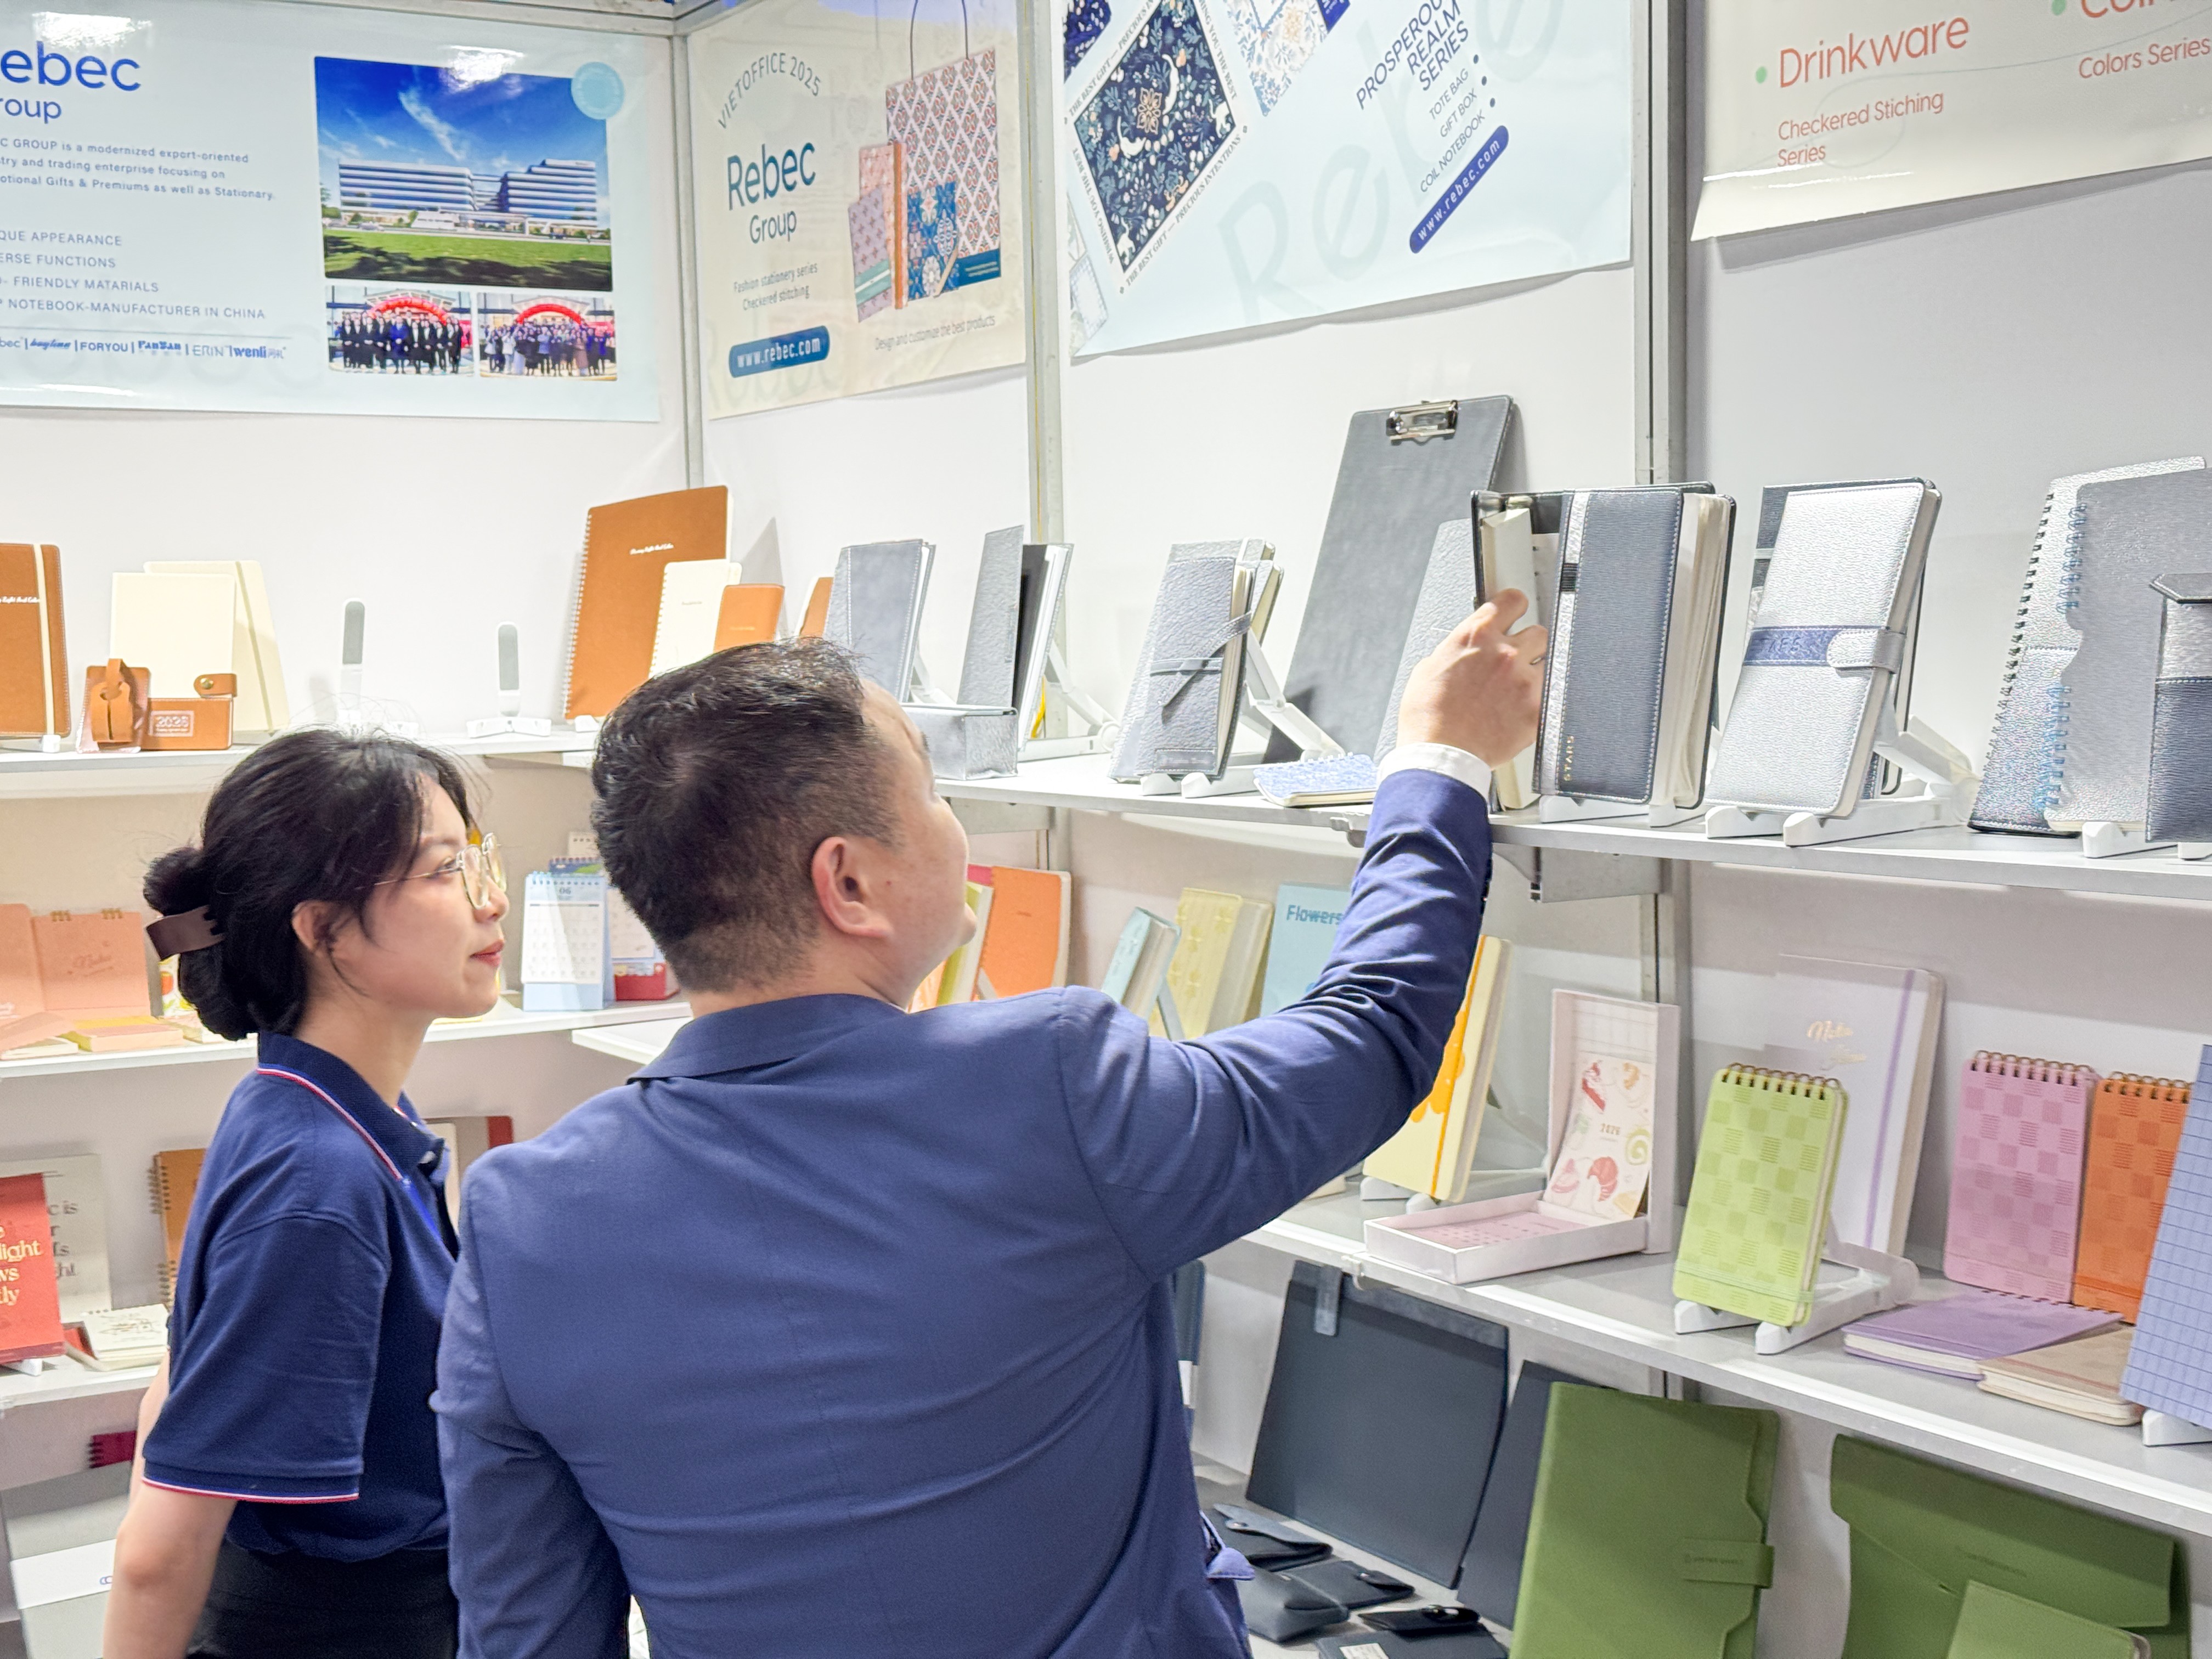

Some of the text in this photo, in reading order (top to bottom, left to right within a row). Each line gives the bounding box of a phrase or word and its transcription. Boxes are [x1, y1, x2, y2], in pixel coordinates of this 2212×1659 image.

[1407, 0, 1461, 75] REALM
[1419, 20, 1469, 91] SERIES
[1779, 15, 1970, 88] Drinkware
[2079, 37, 2211, 78] Colors Series
[0, 41, 142, 92] ebec
[789, 56, 821, 97] 2025
[1069, 6, 1147, 116] THE BEST GIFT PRECIOUS
[1209, 24, 1220, 49] YOU
[1216, 48, 1228, 74] THE
[1224, 72, 1238, 100] BEST
[0, 98, 62, 124] oup
[1429, 68, 1469, 120] TOTE BAG
[1440, 88, 1477, 138] GIFT BOX
[1778, 92, 1944, 140] Checkered Stiching
[0, 156, 225, 179] try and trading enterprise focusing on
[13, 139, 57, 150] GROUP
[87, 145, 155, 157] modernized
[159, 149, 249, 163] export-oriented
[1420, 109, 1486, 192] COIL NOTEBOOK
[1778, 144, 1826, 167] Series
[46, 176, 74, 187] Gifts
[79, 178, 87, 188] &
[92, 179, 150, 191] Premiums
[154, 184, 167, 193] as
[171, 184, 194, 194] well
[198, 187, 211, 195] as
[727, 143, 816, 211] Rebec
[1418, 140, 1500, 241] www.rebec.com
[31, 232, 122, 246] APPEARANCE
[749, 210, 797, 244] Group
[1126, 267, 1139, 286] THE
[1137, 249, 1154, 272] BEST
[1152, 230, 1167, 252] GIFT
[1175, 182, 1206, 223] PRECIOUS
[37, 255, 116, 268] FUNCTIONS
[733, 279, 759, 293] Fashion
[797, 262, 817, 277] series
[14, 276, 79, 289] FRIENDLY
[84, 279, 159, 292] MATARIALS
[8, 299, 200, 317] NOTEBOOK-MANUFACTURER
[205, 307, 218, 317] IN
[224, 308, 265, 319] CHINA
[80, 342, 128, 352] FORYOU
[737, 337, 821, 368] www.rebec.com
[1564, 735, 1574, 781] STARS
